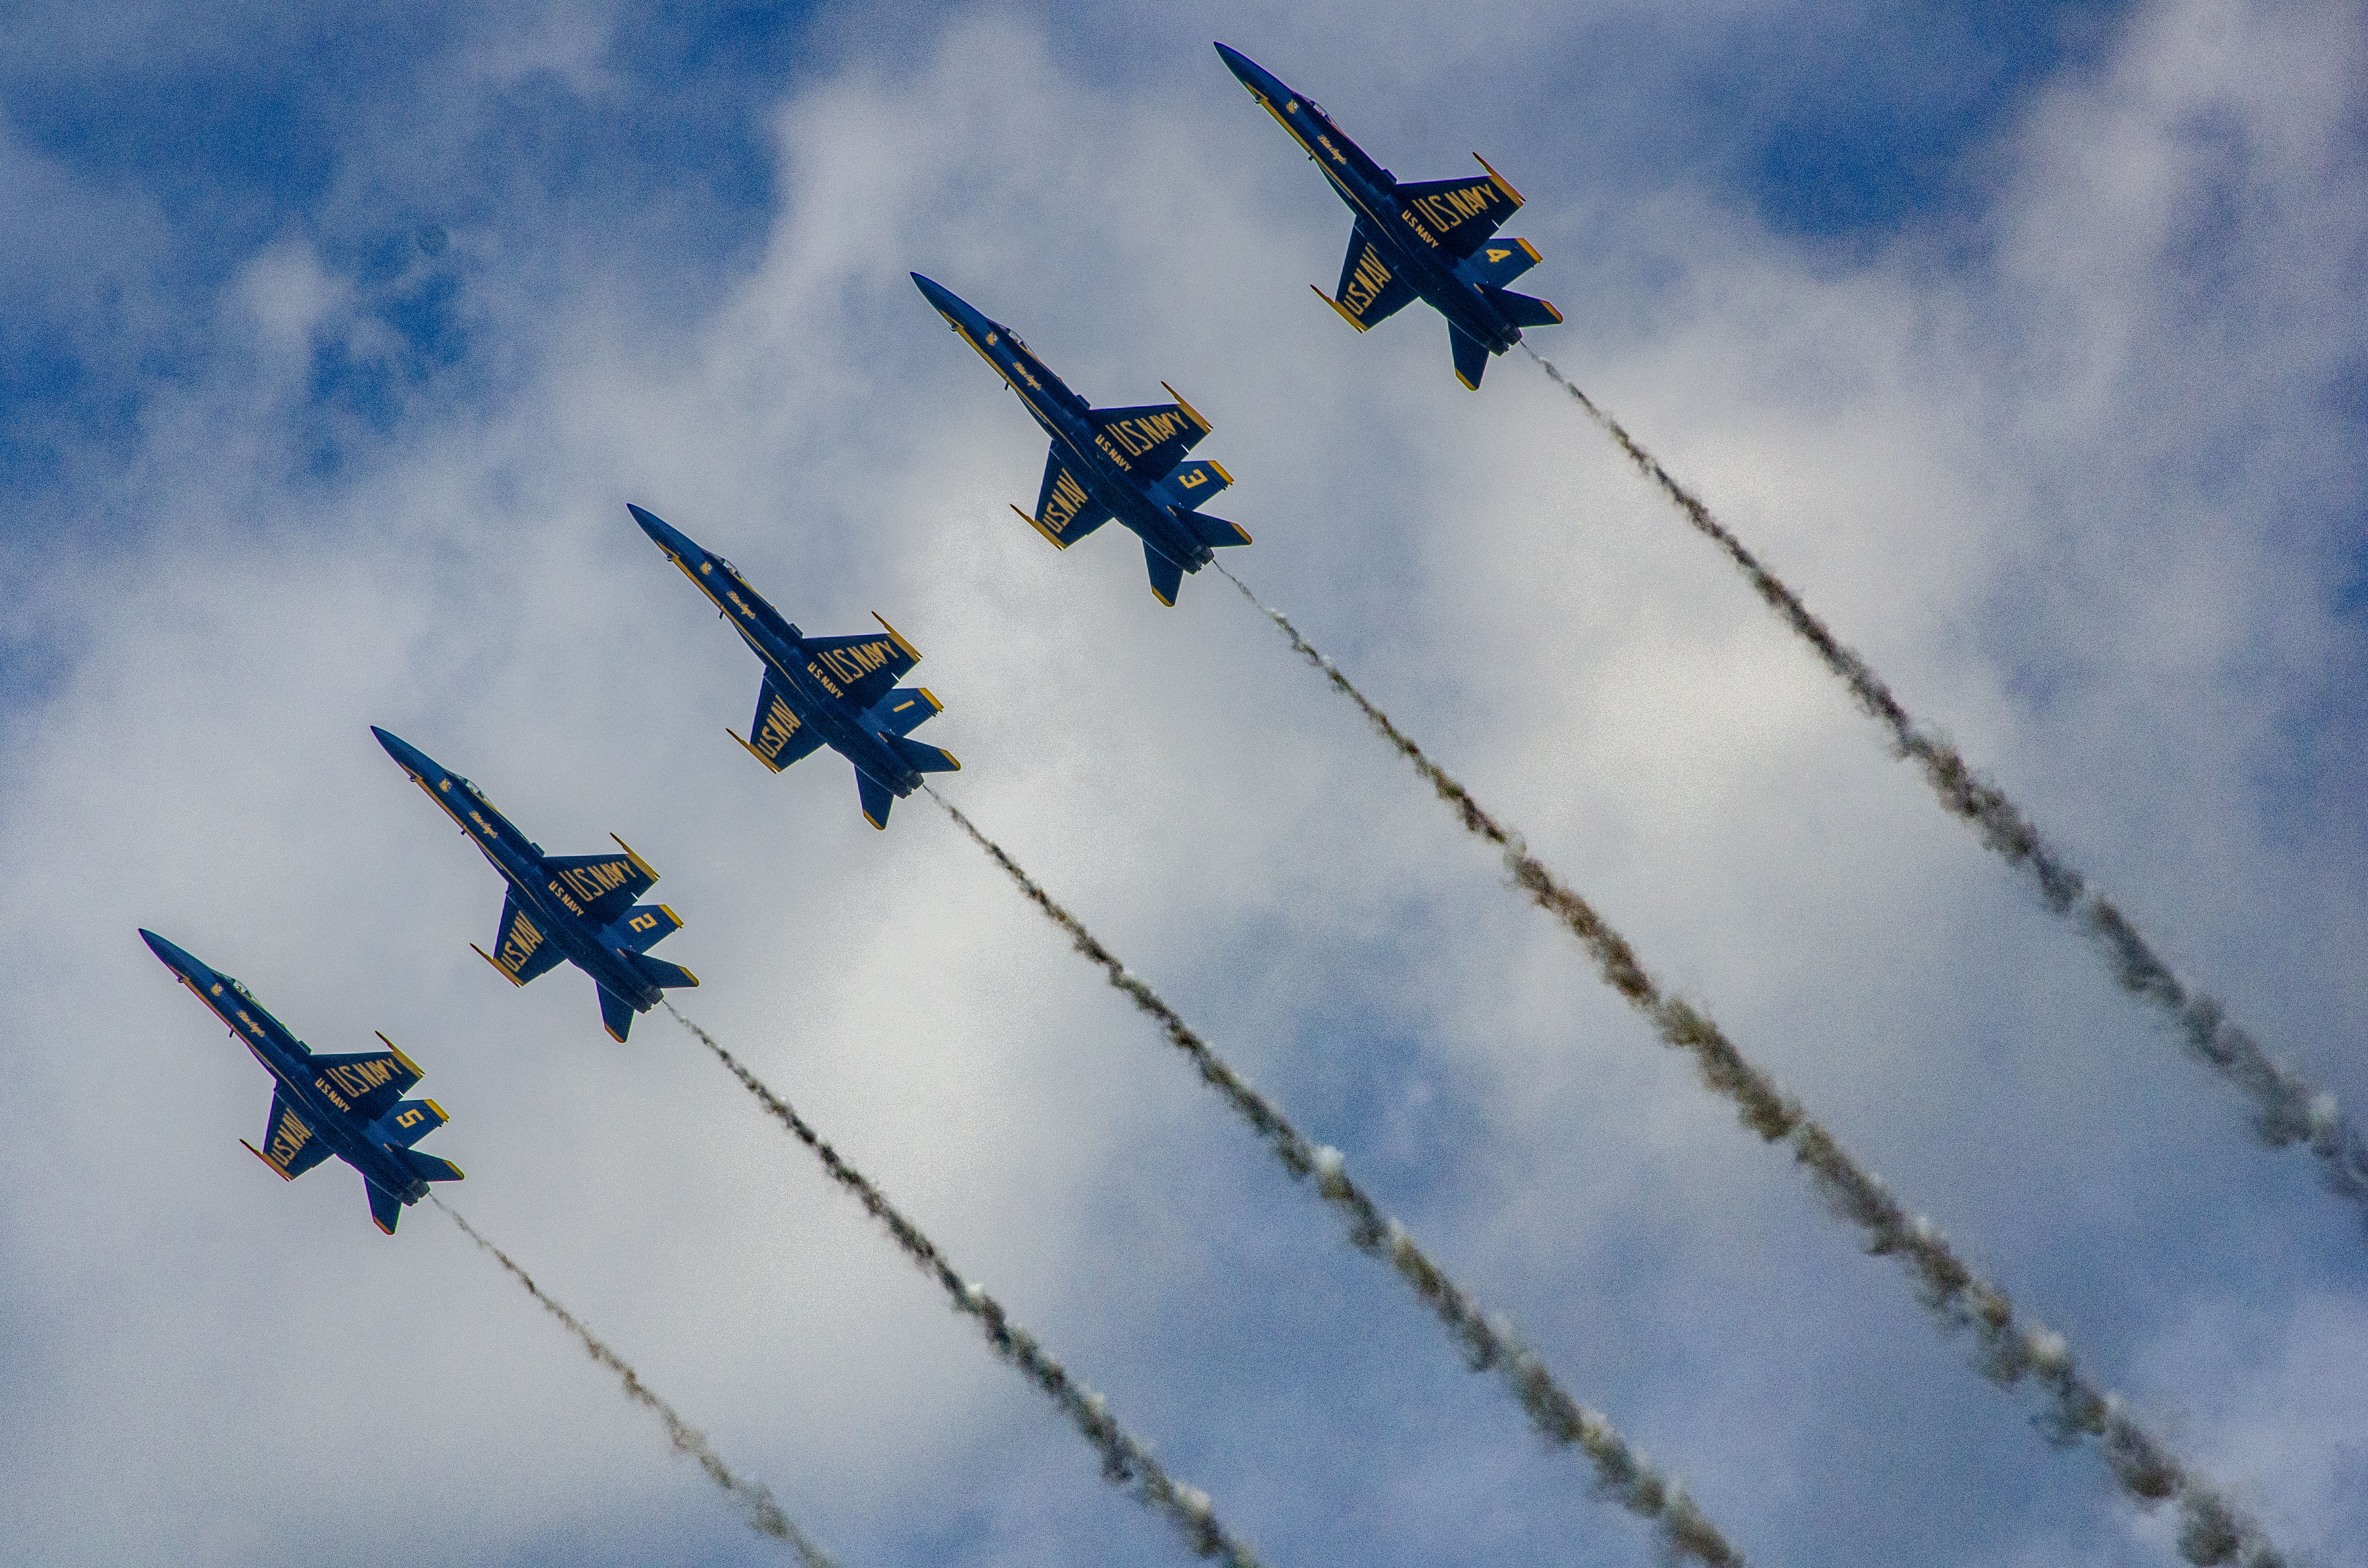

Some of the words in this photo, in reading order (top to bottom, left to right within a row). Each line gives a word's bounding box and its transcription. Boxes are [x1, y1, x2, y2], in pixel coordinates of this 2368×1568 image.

[1444, 184, 1499, 219] NAVY
[1415, 224, 1439, 248] NAVY
[1486, 249, 1511, 263] 4
[1354, 242, 1392, 298] NAV
[1135, 411, 1188, 444] NAVY
[1108, 448, 1132, 471] NAVY
[1178, 469, 1208, 489] 3
[847, 641, 899, 673] NAVY
[821, 676, 844, 698] NAVY
[893, 700, 915, 712] 1
[587, 861, 637, 890] NAVY
[561, 894, 584, 917] NAVY
[629, 913, 658, 932] 2
[352, 1058, 402, 1088] NAVY
[328, 1090, 350, 1113] NAVY
[396, 1109, 425, 1128] 5
